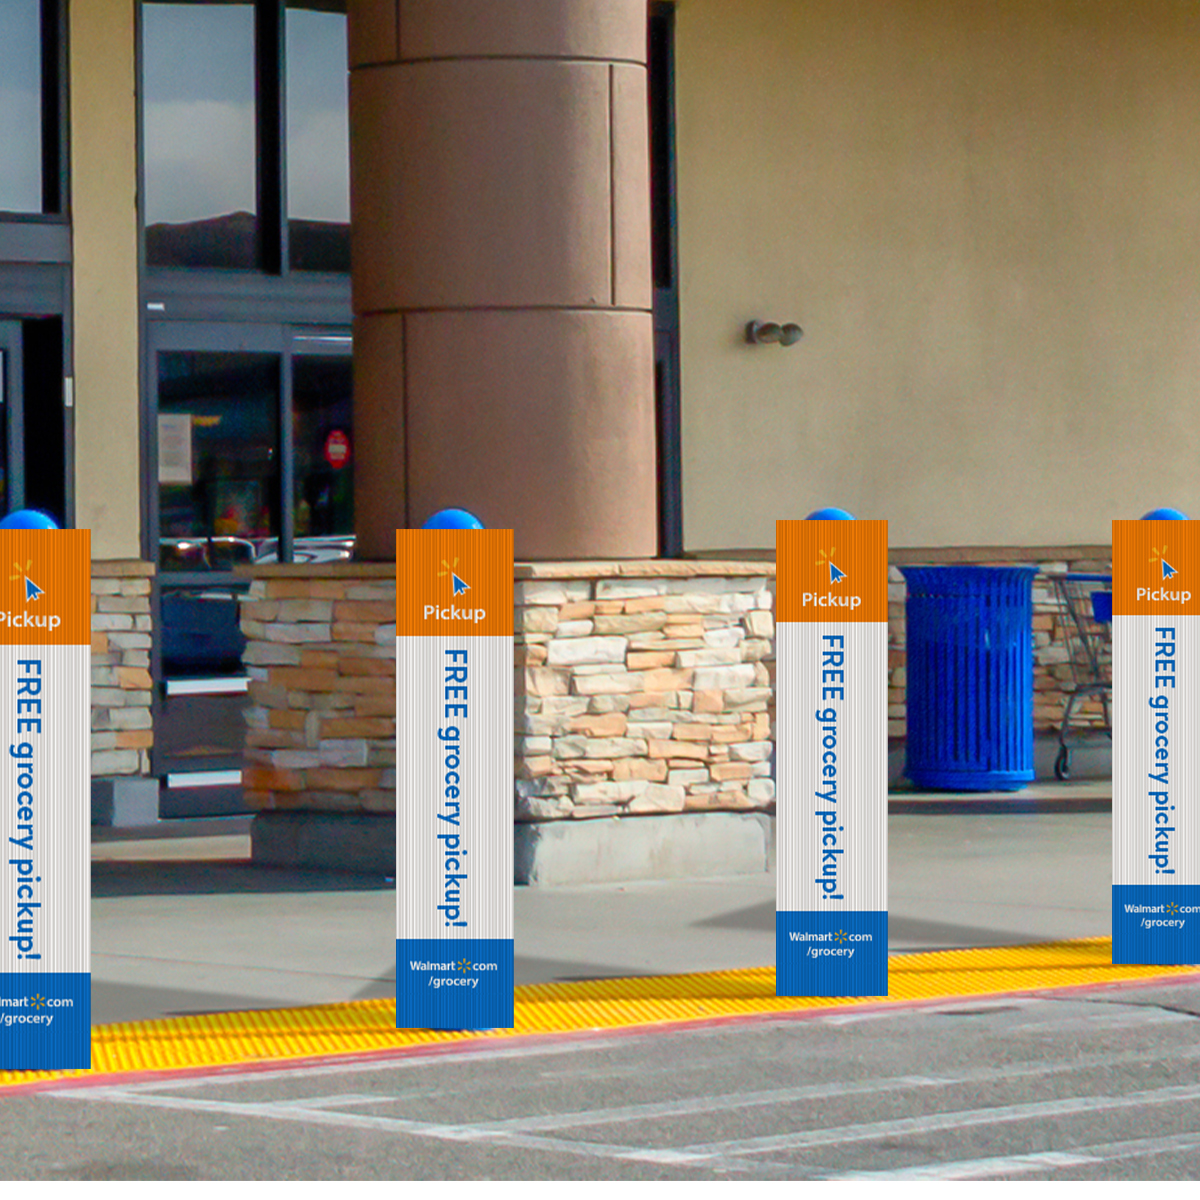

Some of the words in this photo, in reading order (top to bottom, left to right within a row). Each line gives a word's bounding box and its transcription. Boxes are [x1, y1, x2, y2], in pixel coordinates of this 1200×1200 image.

[423, 604, 486, 624] Pickup
[802, 591, 862, 611] Pickup
[1136, 586, 1192, 605] Pickup
[444, 649, 468, 719] FREE
[822, 635, 845, 701] FREE
[1154, 627, 1176, 689] FREE
[16, 659, 42, 734] FREE
[814, 707, 837, 804] grocery
[1147, 695, 1169, 785] grocery
[8, 741, 34, 851] grocery
[436, 725, 460, 827] grocery
[814, 810, 845, 900] pickup!
[1147, 791, 1176, 875] pickup!
[8, 859, 42, 960] pickup!
[436, 833, 468, 928] pickup!
[1124, 904, 1165, 914] Walmart
[788, 931, 834, 942] Walmart
[848, 933, 873, 942] com
[806, 946, 855, 959] /grocery
[1140, 917, 1186, 930] /grocery
[409, 960, 457, 971] Walmart
[472, 962, 498, 971] com
[428, 976, 479, 989] /grocery
[0, 1012, 54, 1027] /grocery
[46, 998, 74, 1008] com
